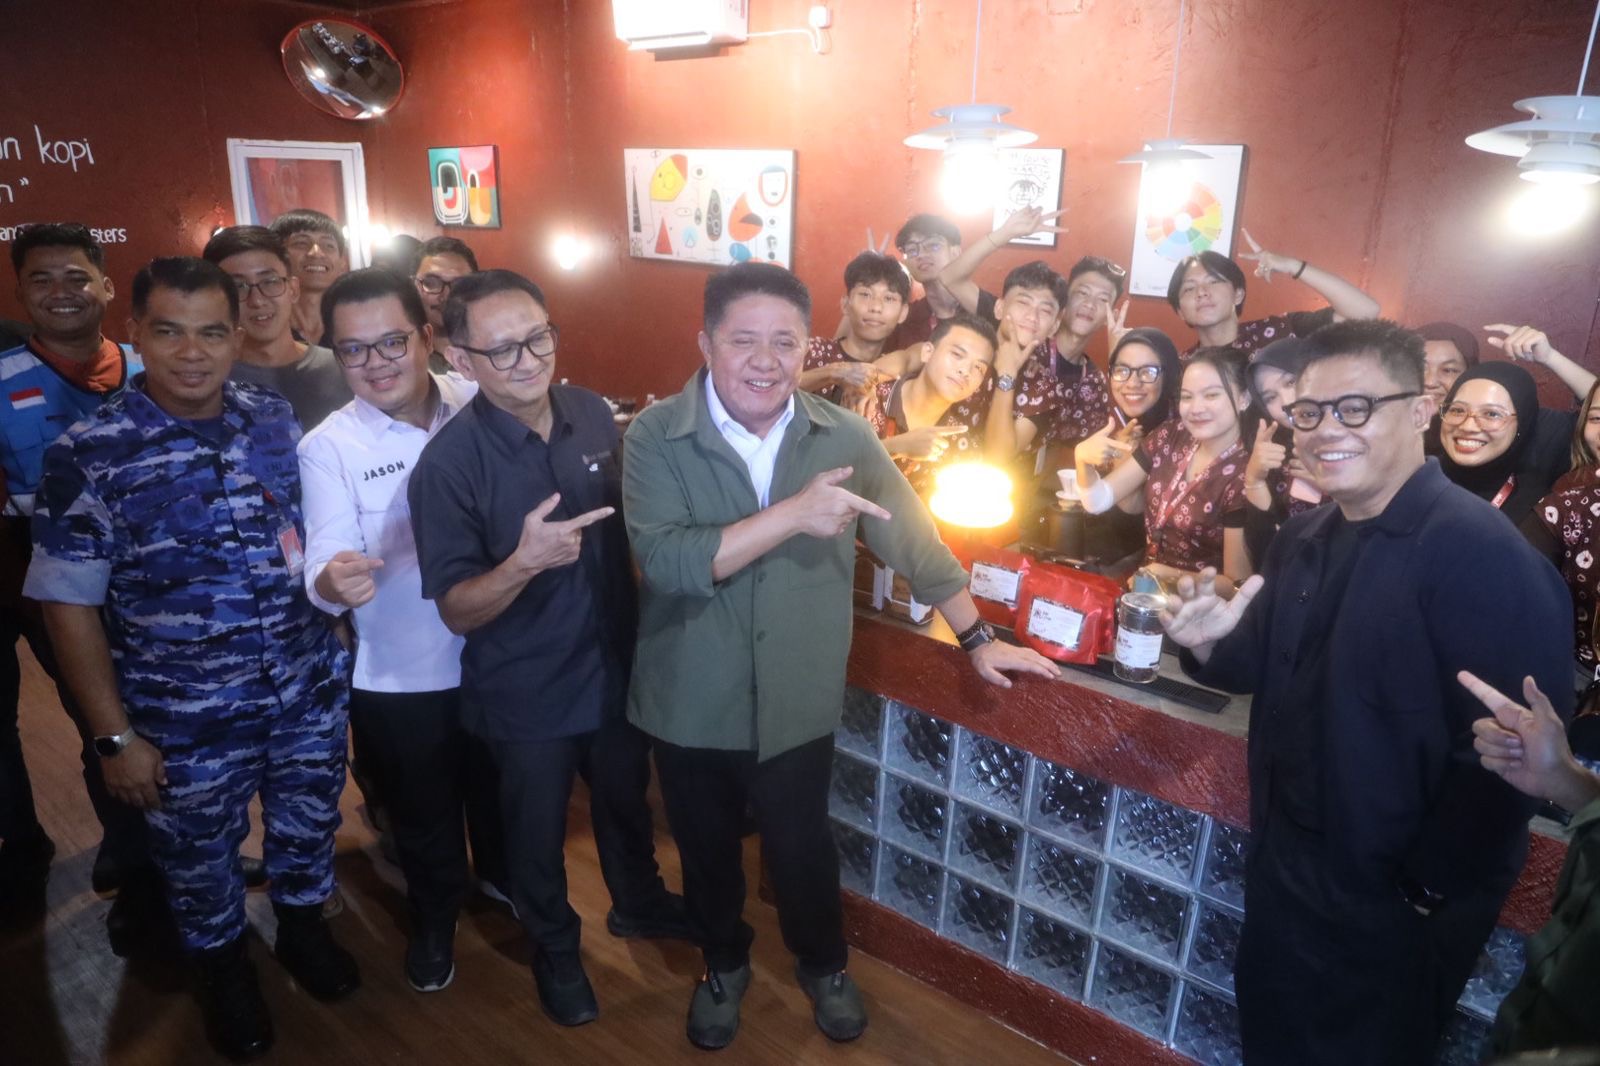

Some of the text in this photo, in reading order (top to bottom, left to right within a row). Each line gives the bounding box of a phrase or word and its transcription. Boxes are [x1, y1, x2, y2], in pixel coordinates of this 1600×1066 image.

[0, 124, 95, 173] n kopi
[0, 226, 127, 243] an sters
[364, 460, 405, 481] JASON
